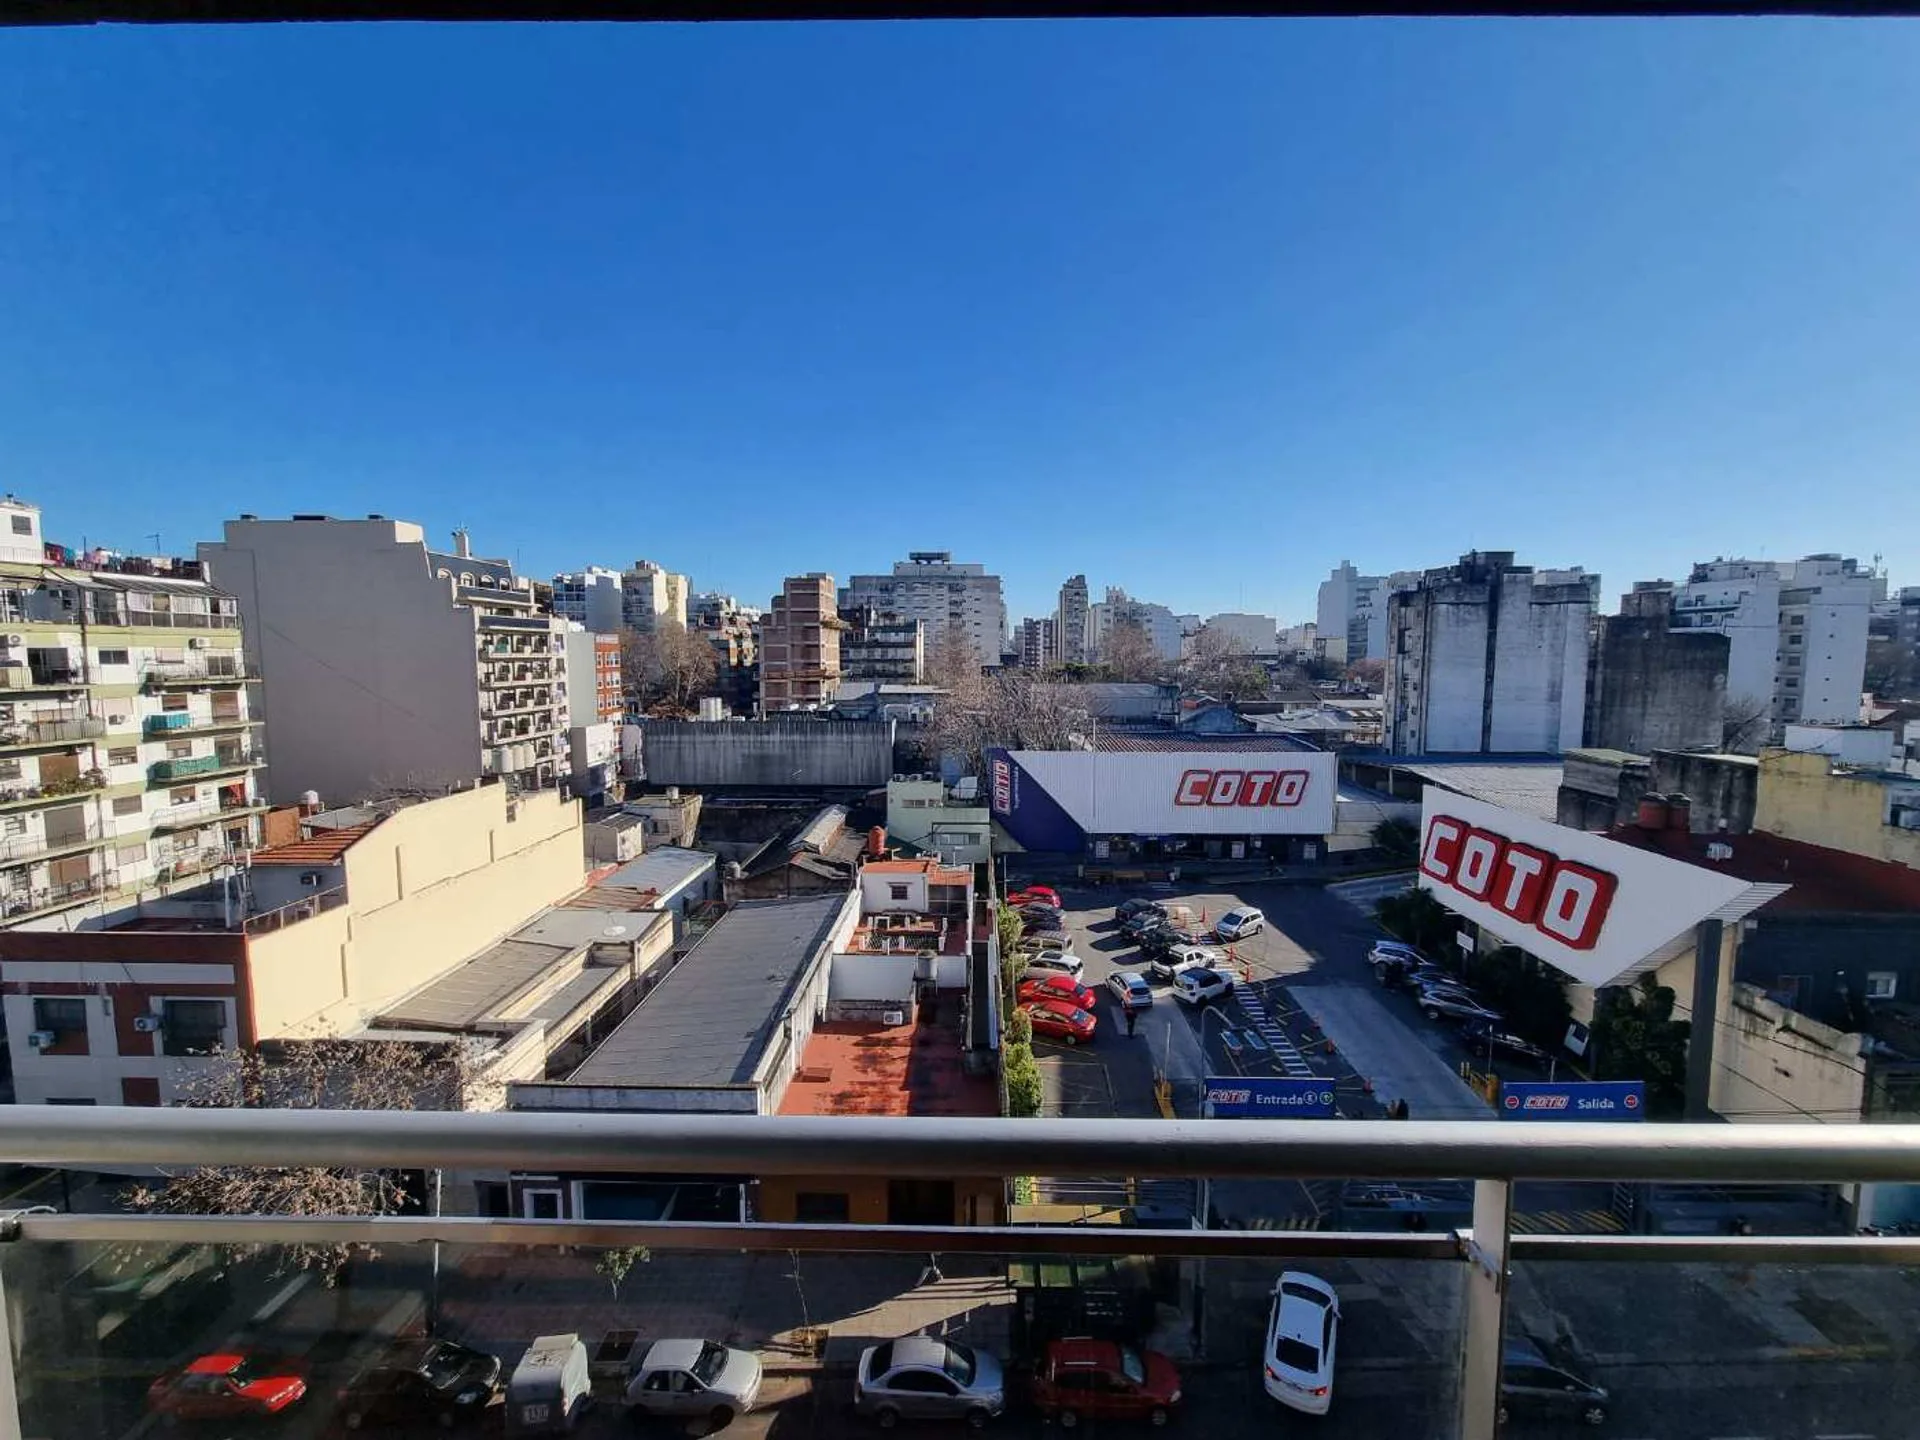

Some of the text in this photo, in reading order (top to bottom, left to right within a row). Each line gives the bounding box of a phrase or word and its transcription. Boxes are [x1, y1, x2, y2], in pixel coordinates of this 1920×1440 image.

[1175, 769, 1310, 806] COTO
[1420, 815, 1618, 950] COTO
[1256, 1094, 1303, 1105] Entrada
[1577, 1098, 1615, 1109] Salida
